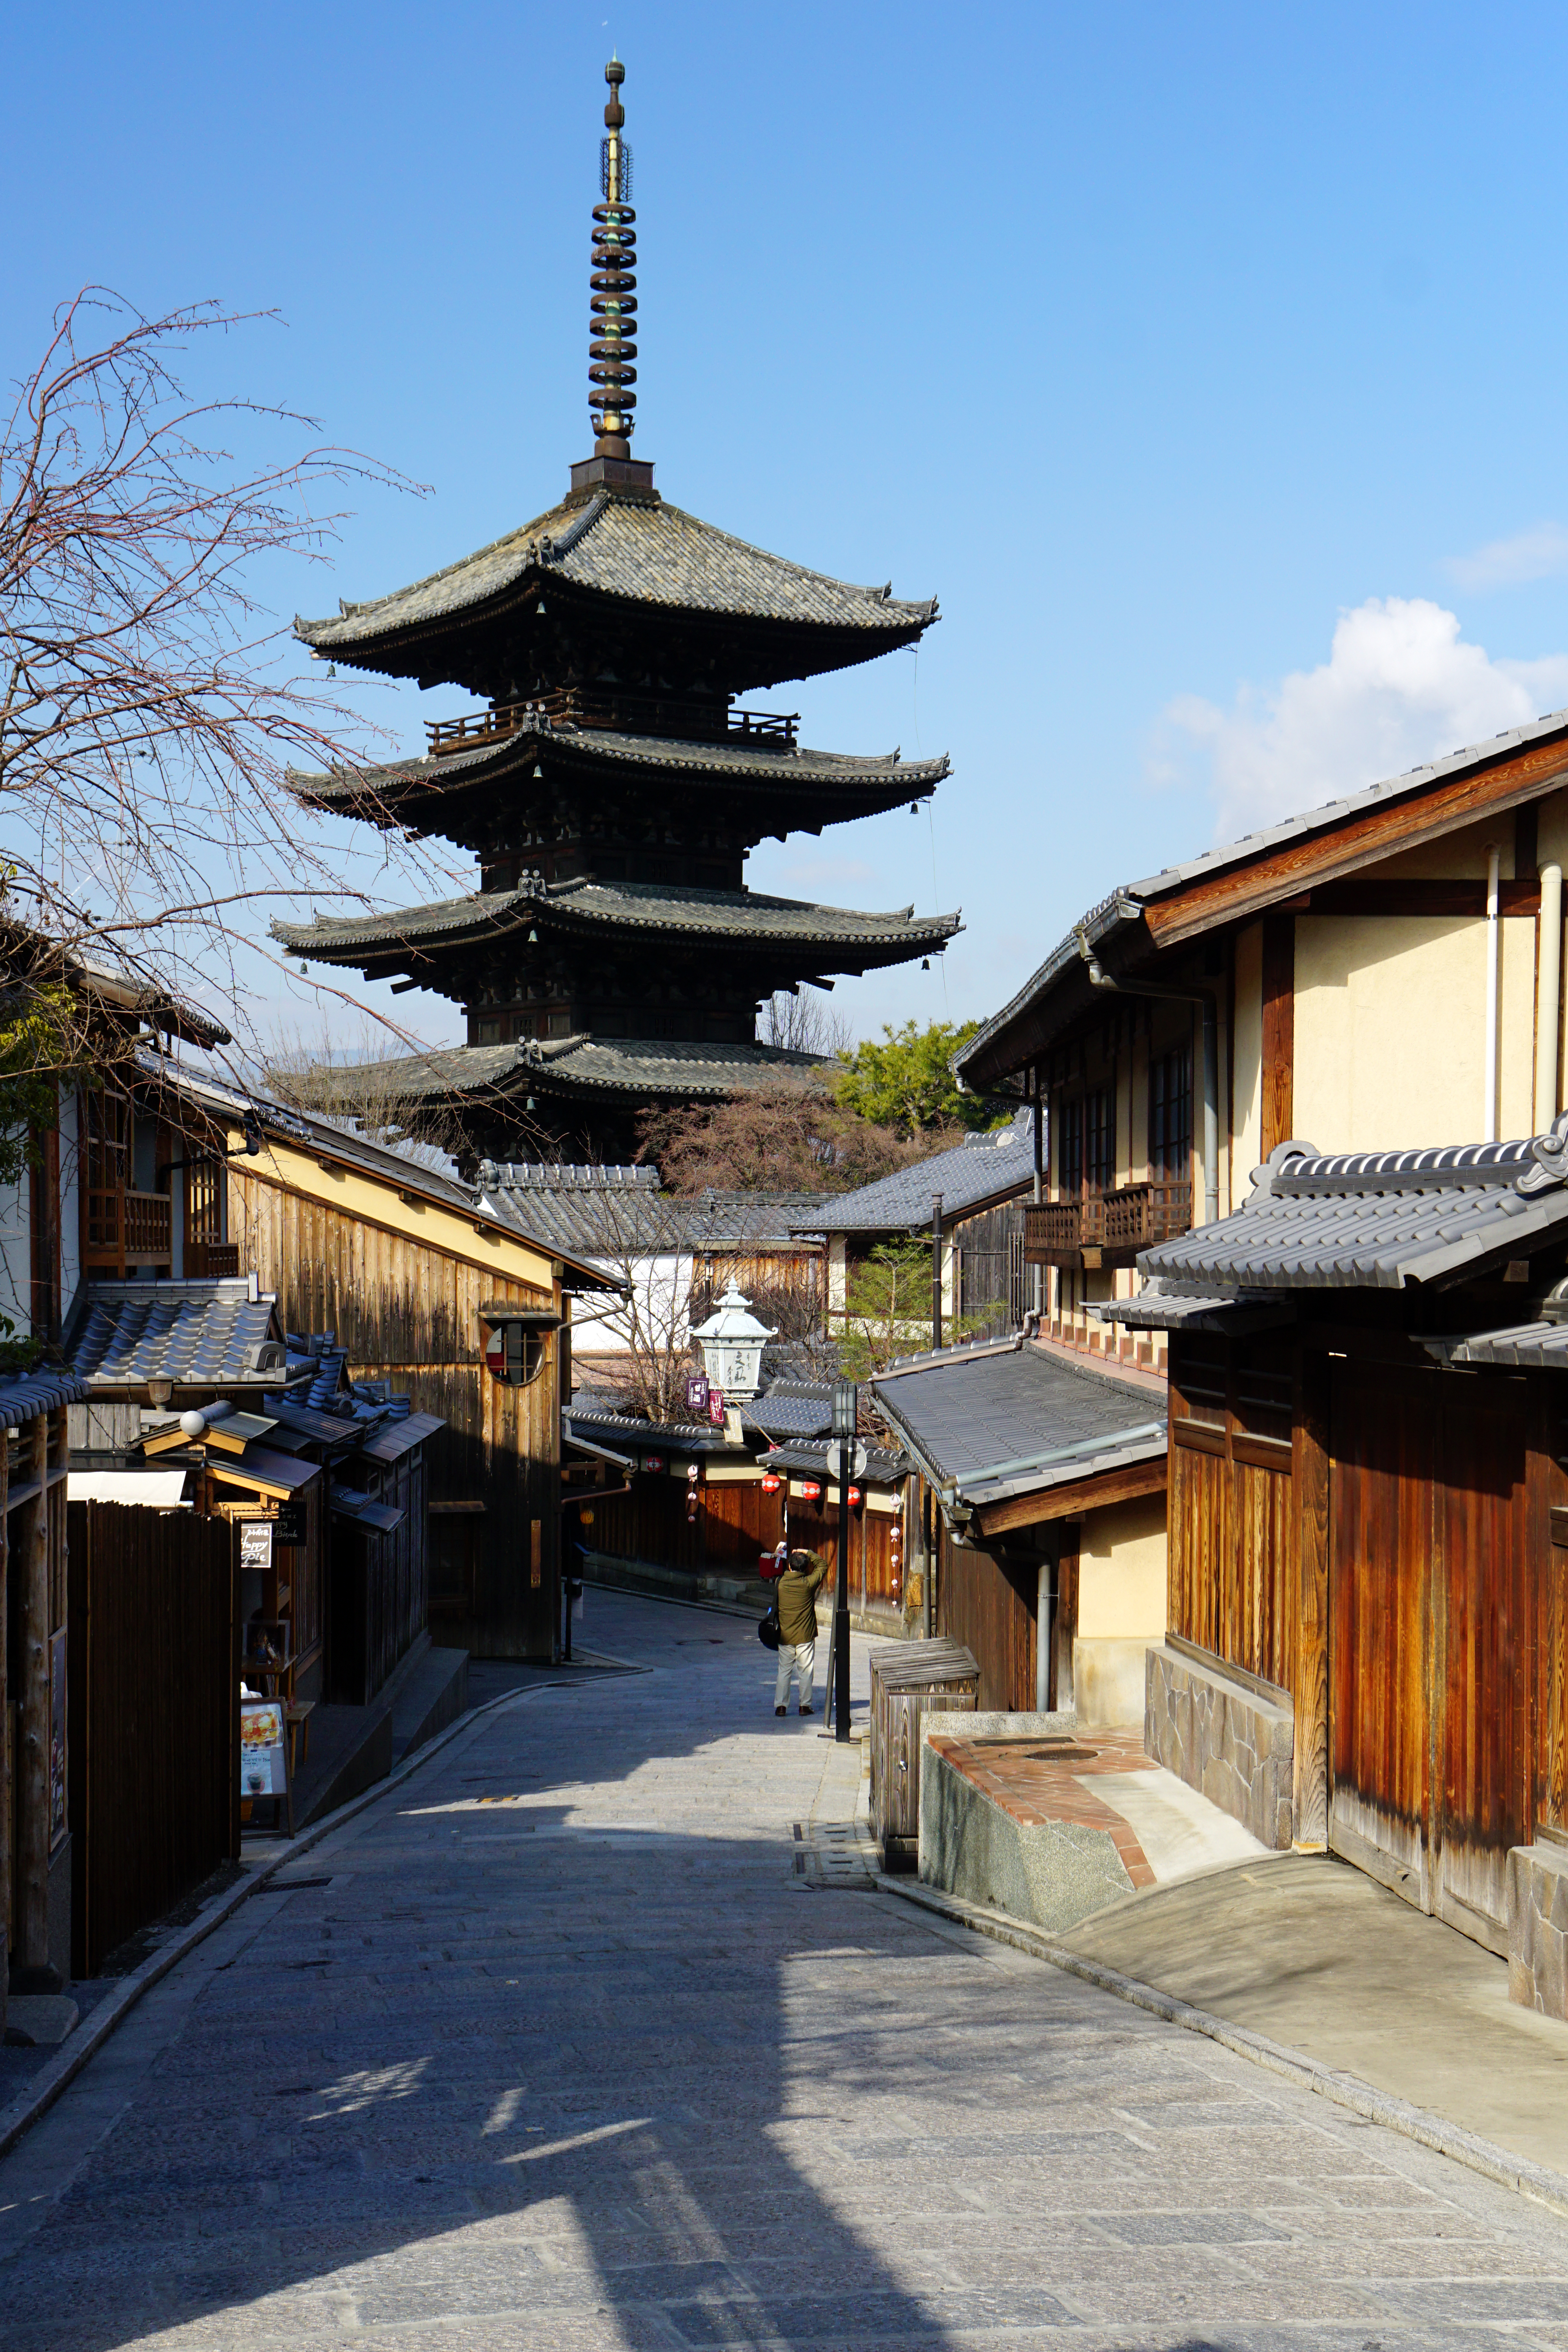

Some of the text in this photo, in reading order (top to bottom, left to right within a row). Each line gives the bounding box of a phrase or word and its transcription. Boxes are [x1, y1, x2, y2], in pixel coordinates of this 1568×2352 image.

[693, 1384, 701, 1403] 甘酒
[241, 1535, 268, 1551] Happy
[241, 1553, 266, 1563] Pie
